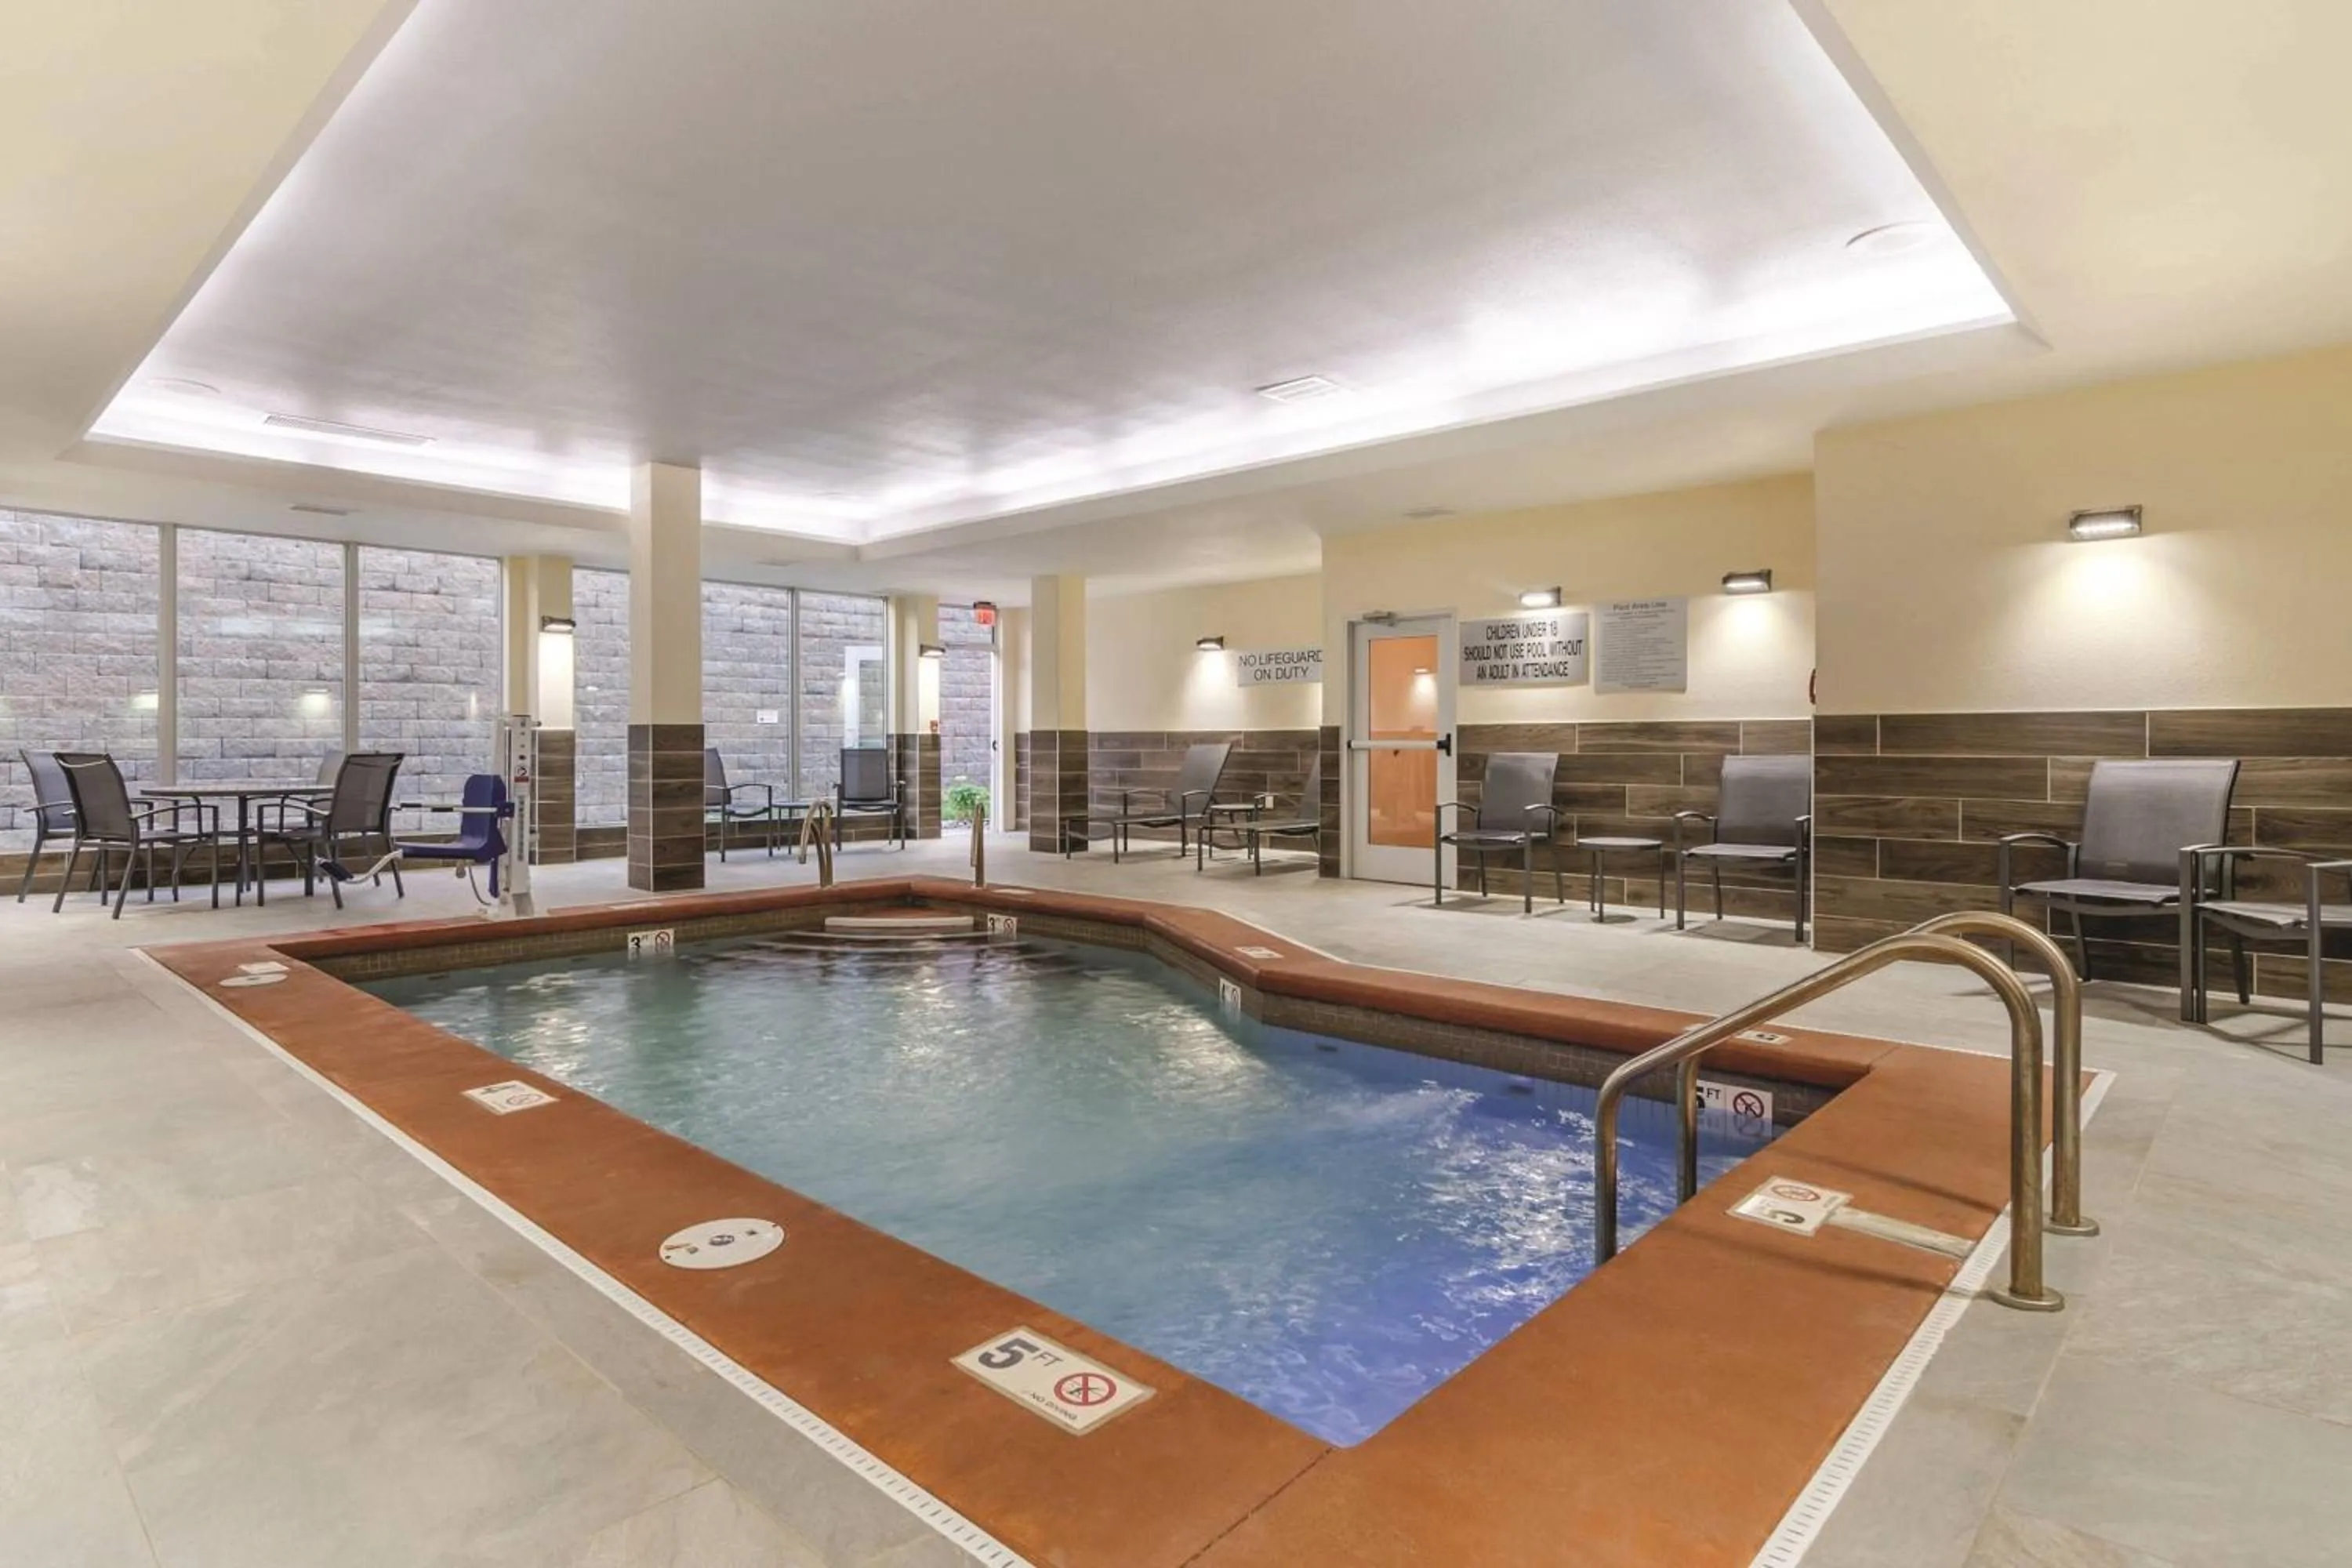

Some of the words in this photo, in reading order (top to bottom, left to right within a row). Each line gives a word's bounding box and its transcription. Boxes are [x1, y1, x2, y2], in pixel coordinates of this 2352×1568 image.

[1486, 623, 1519, 641] CHILDREN
[1522, 622, 1547, 638] UNDER
[1463, 645, 1490, 661] SHOULD
[1494, 644, 1508, 659] NOT
[1510, 643, 1525, 659] USE
[1527, 641, 1546, 658] POOL
[1549, 639, 1583, 657] WITHOUT
[1239, 654, 1256, 666] NO
[1254, 668, 1271, 681] ON
[1276, 666, 1308, 680] DUTY
[1477, 664, 1487, 680] AN
[1489, 663, 1509, 679] ADULT
[1512, 663, 1519, 678] IN
[1521, 660, 1569, 678] ATTENDANCE
[1706, 1087, 1722, 1100] FT
[978, 1338, 1041, 1370] 5
[1031, 1351, 1065, 1367] FT
